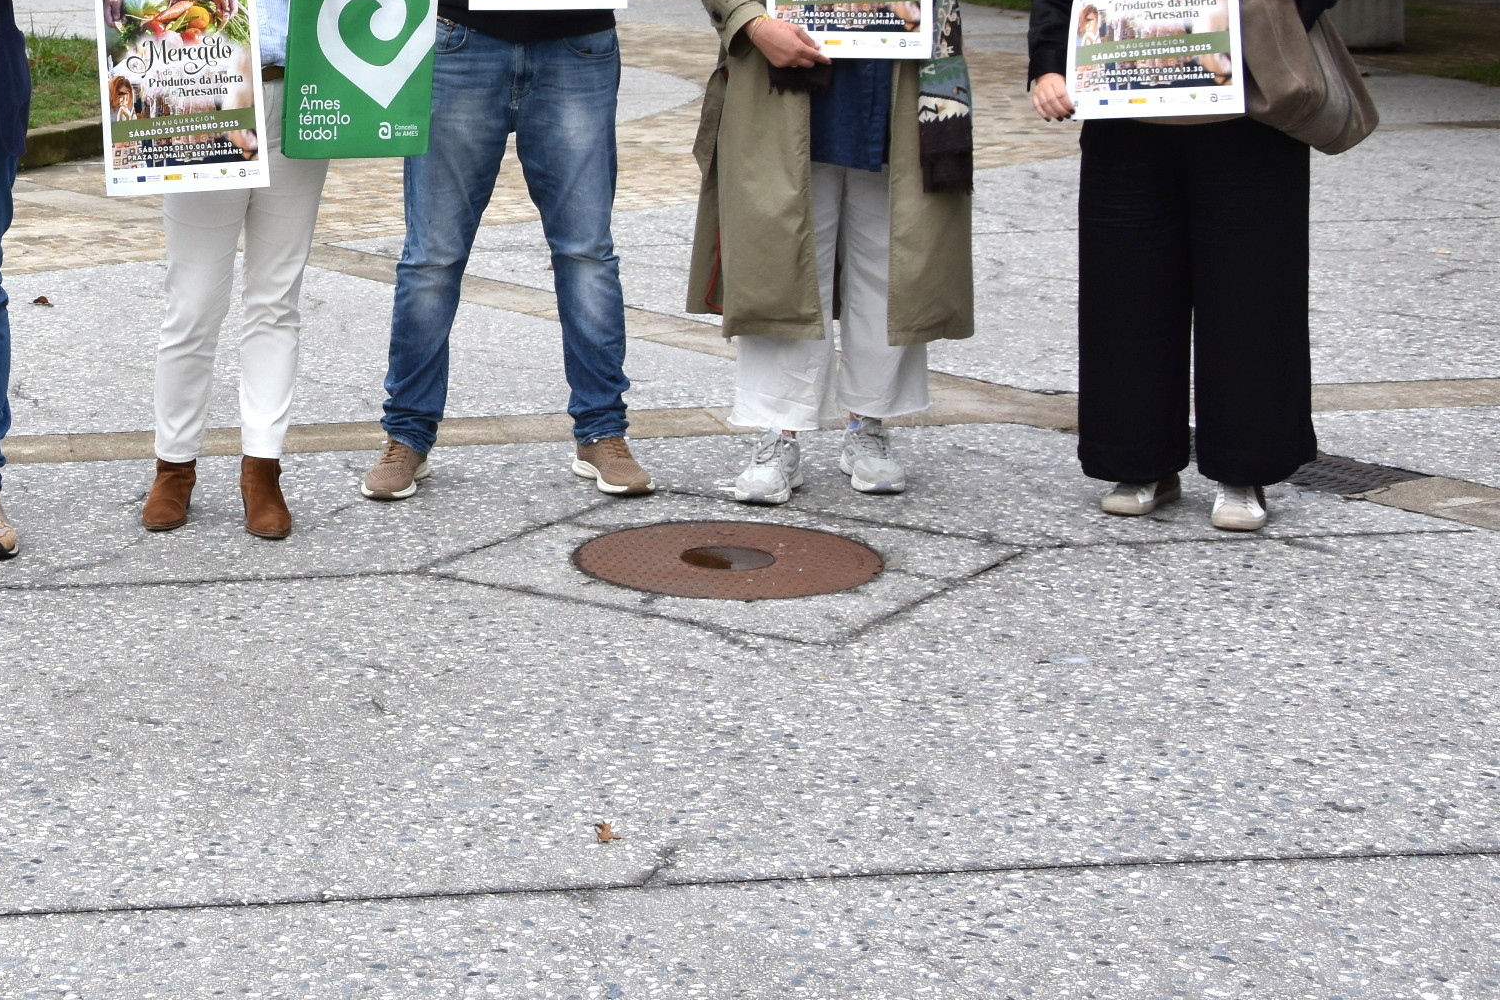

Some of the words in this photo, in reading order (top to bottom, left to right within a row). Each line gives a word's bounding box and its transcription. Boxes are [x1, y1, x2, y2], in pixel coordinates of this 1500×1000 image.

[1113, 0, 1164, 12] Produtos
[853, 17, 905, 25] BERTAMIRÁNS
[126, 35, 232, 79] Mercado
[1091, 50, 1127, 61] SÁBADO
[1129, 49, 1139, 57] 20
[1141, 45, 1188, 56] SETEMBRO
[1189, 43, 1212, 52] 2025
[148, 77, 196, 88] Produtos
[199, 75, 212, 84] da
[214, 74, 244, 83] Horta
[177, 85, 228, 97] Artesanía
[300, 84, 317, 95] en
[299, 96, 341, 110] Ames
[153, 115, 216, 127] INAUGURACIÓN
[299, 111, 350, 125] témolo
[128, 127, 163, 138] SÁBADO
[164, 126, 174, 134] 20
[176, 122, 218, 133] SETEMBRO
[219, 120, 240, 128] 2025
[127, 154, 152, 162] PRAZA
[192, 147, 243, 157] BERTAMIRÁNS
[137, 145, 174, 154] SÁBADOS
[213, 141, 233, 149] 13.30
